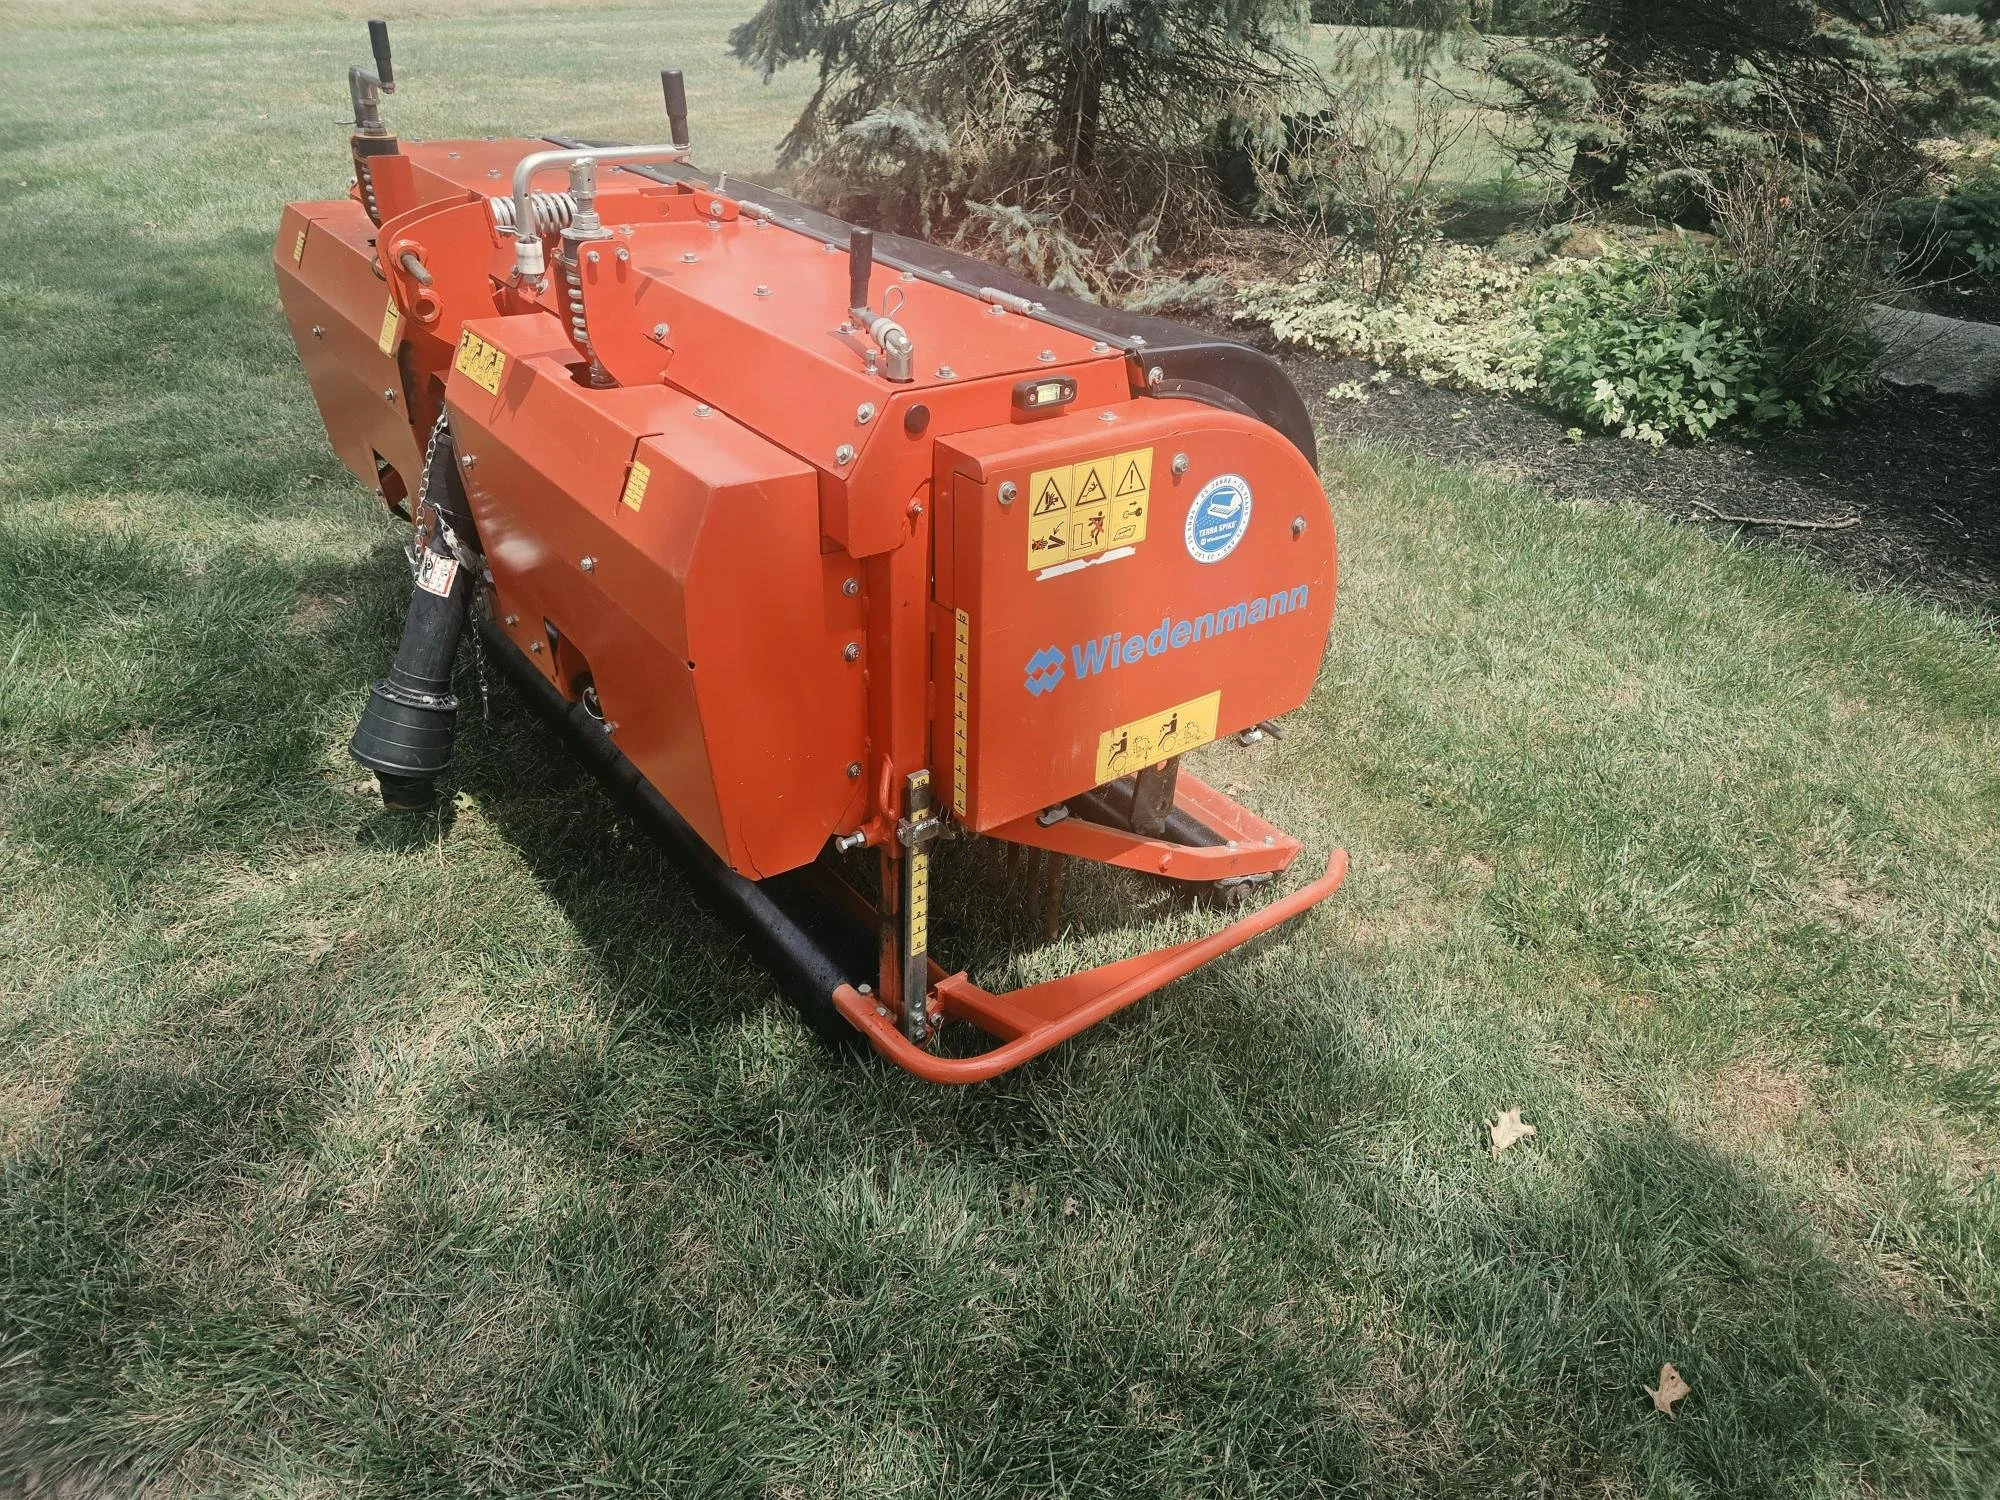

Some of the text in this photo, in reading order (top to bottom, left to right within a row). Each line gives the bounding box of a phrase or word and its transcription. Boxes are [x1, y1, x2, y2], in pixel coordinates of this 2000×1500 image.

[1201, 489, 1208, 498] 25
[1199, 520, 1238, 537] TERRA SPIKE
[1071, 584, 1309, 680] Wiedenmann
[917, 778, 926, 786] 10
